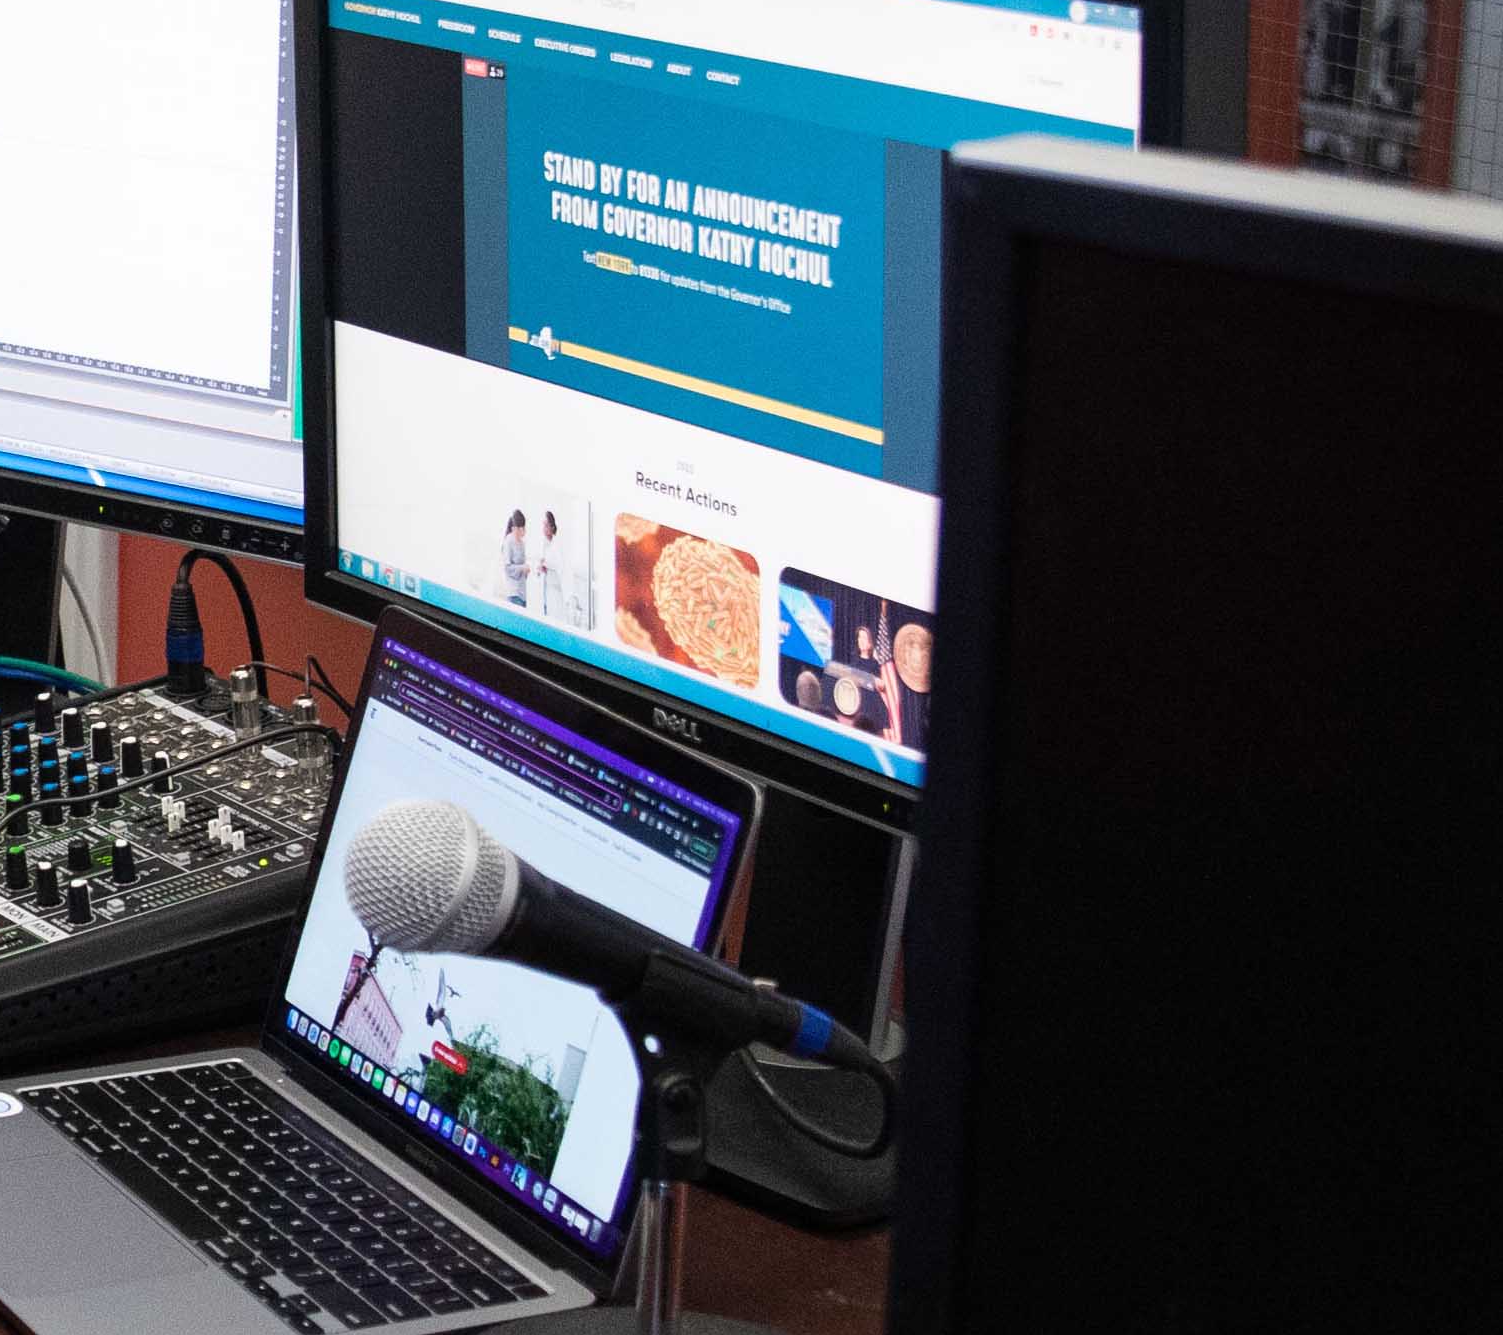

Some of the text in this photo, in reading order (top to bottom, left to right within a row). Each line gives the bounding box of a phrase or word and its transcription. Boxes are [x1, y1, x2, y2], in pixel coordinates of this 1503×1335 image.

[543, 150, 842, 249] STAND BY FOR AN ANNOUNCEMENT
[551, 190, 833, 288] FROM GOVERNOR KATHY HOCHUL
[583, 250, 596, 264] Text
[660, 270, 670, 283] for
[671, 275, 699, 291] updates
[700, 280, 717, 295] from
[717, 285, 730, 299] the
[731, 288, 768, 308] Governor's
[768, 297, 791, 314] Office
[635, 471, 738, 517] Recent Actions
[652, 707, 703, 743] DELL
